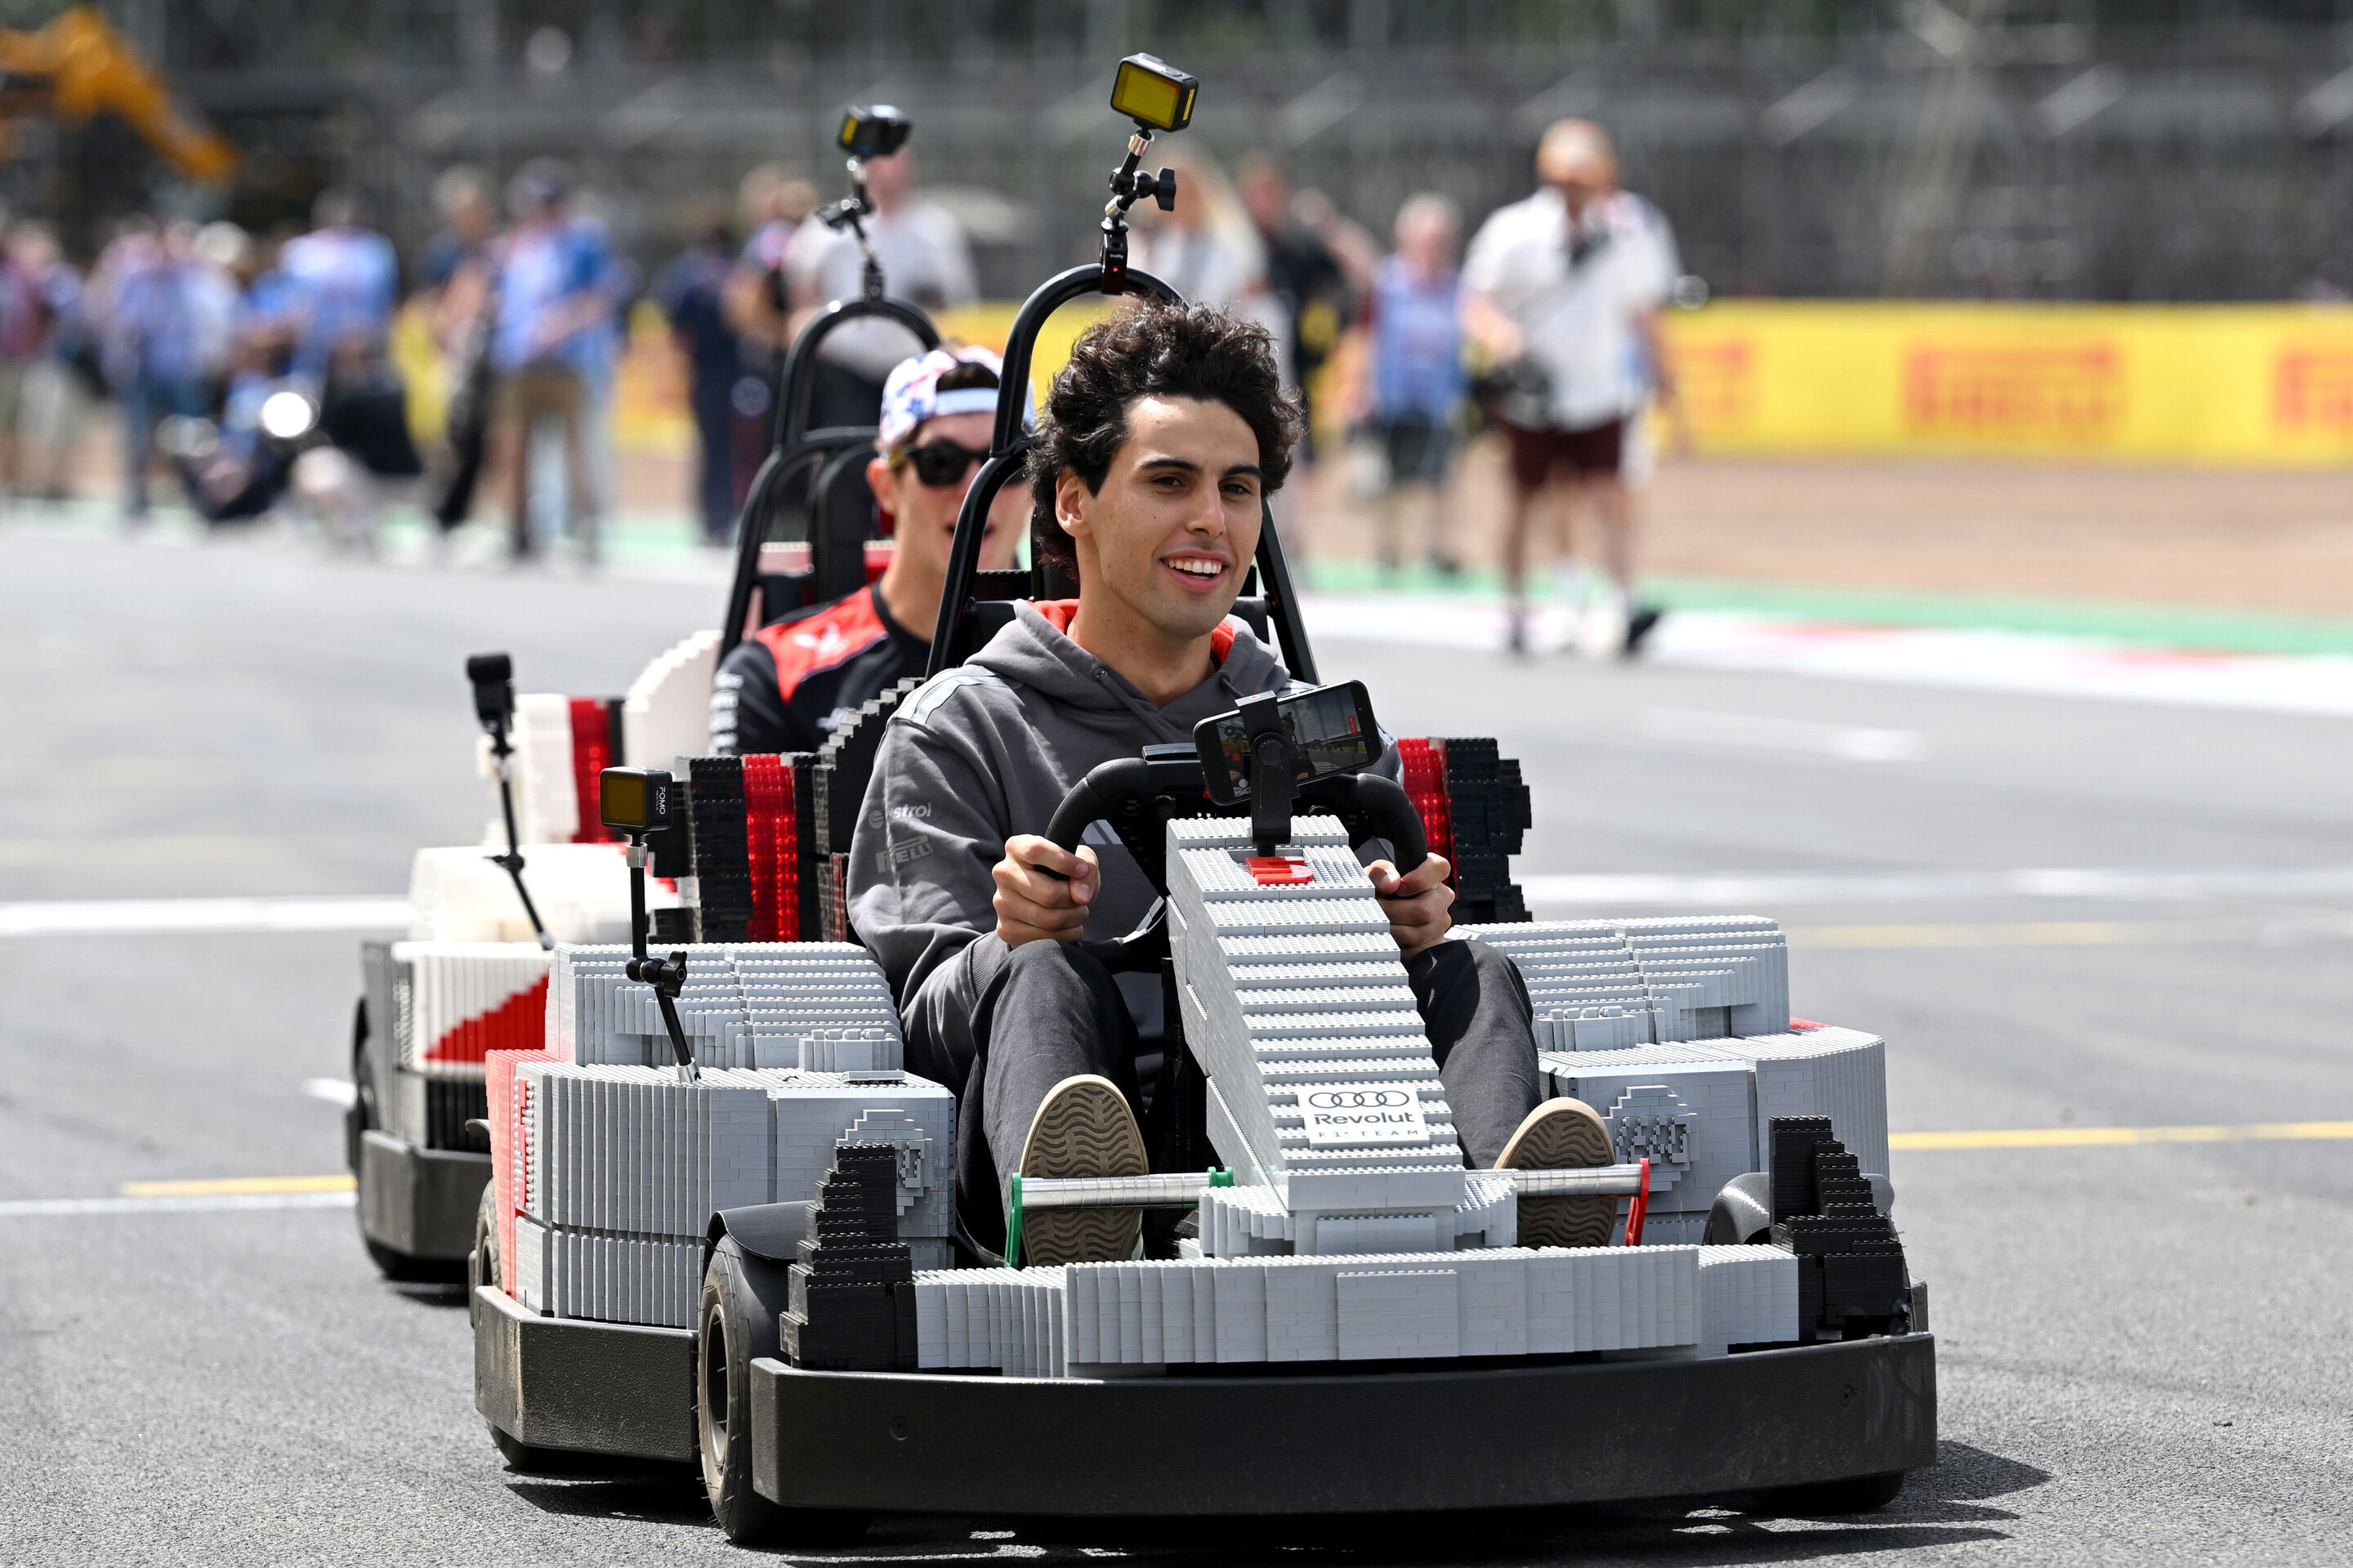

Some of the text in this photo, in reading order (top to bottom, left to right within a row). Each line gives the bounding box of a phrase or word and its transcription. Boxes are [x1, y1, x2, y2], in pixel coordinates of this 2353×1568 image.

[889, 802, 931, 818] strol
[1314, 1112, 1415, 1125] Revolut
[1361, 1129, 1418, 1137] TEAM
